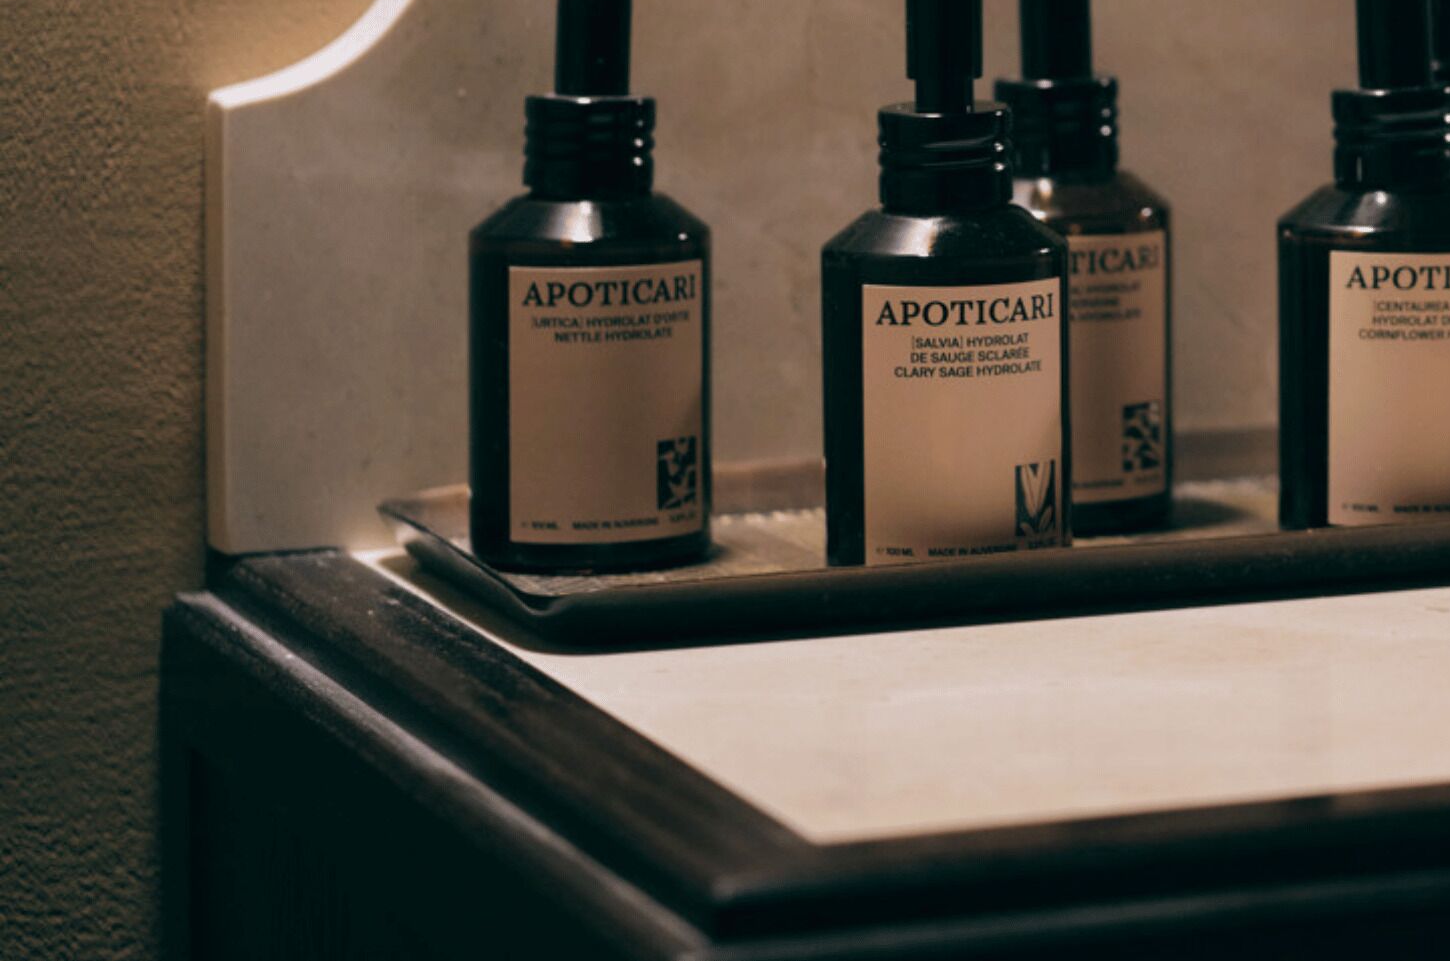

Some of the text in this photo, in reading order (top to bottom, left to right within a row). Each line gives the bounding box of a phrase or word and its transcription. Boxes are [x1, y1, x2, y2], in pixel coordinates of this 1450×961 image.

[523, 275, 695, 307] APOTICARI
[876, 293, 1053, 326] APOTICARI
[966, 332, 1029, 348] HYDROLAT
[910, 346, 1030, 364] DE SAUGE SCLARÉE
[894, 360, 1042, 379] CLARY SAGE HYDROLATE
